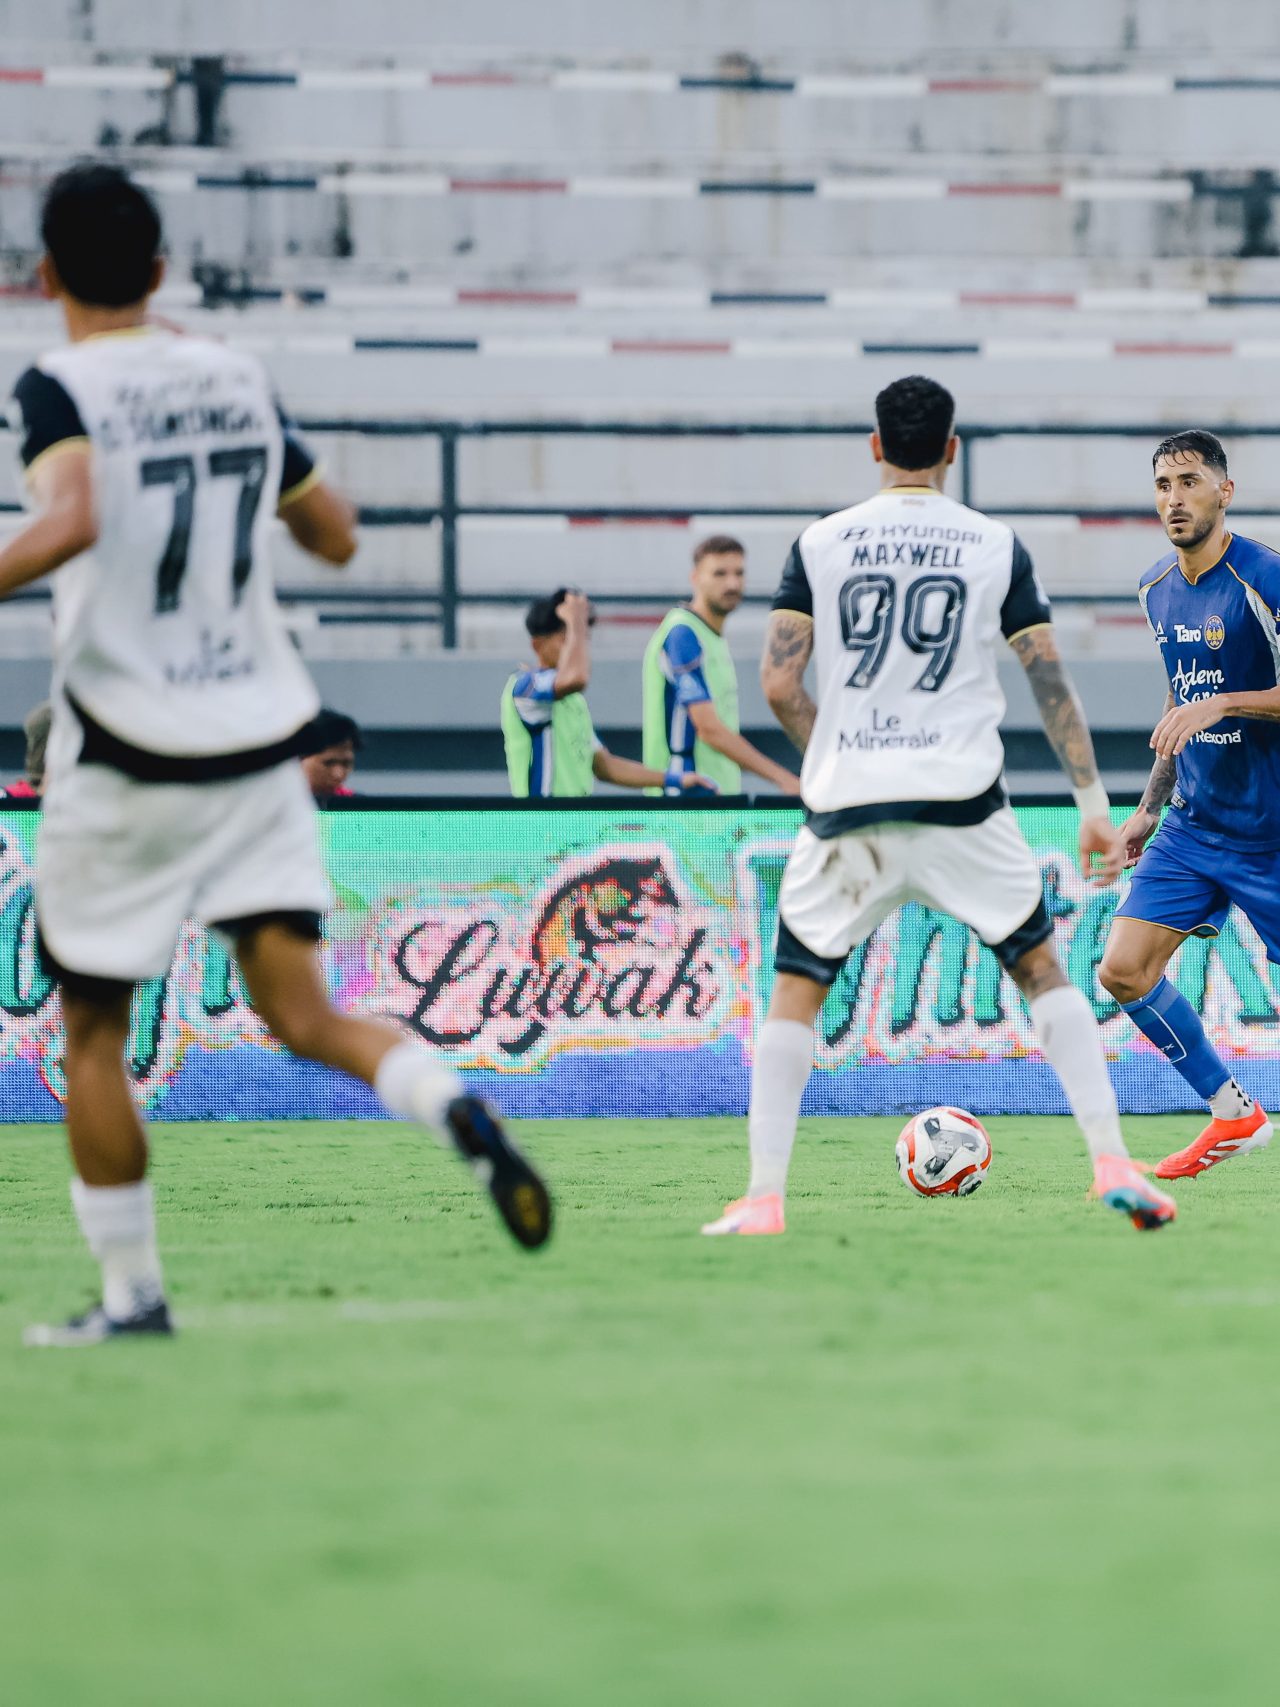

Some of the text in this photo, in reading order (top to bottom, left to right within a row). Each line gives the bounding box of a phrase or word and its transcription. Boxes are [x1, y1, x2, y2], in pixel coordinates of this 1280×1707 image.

[140, 445, 268, 616] 77
[880, 525, 983, 544] HYUNDAI
[850, 542, 965, 568] MAXWELL
[838, 572, 968, 692] 99
[1173, 624, 1202, 643] Taro
[1171, 658, 1225, 692] Adem
[872, 708, 901, 732] Le
[837, 726, 942, 752] Minerale
[1195, 729, 1242, 745] Rexona
[376, 920, 718, 1056] Luwak
